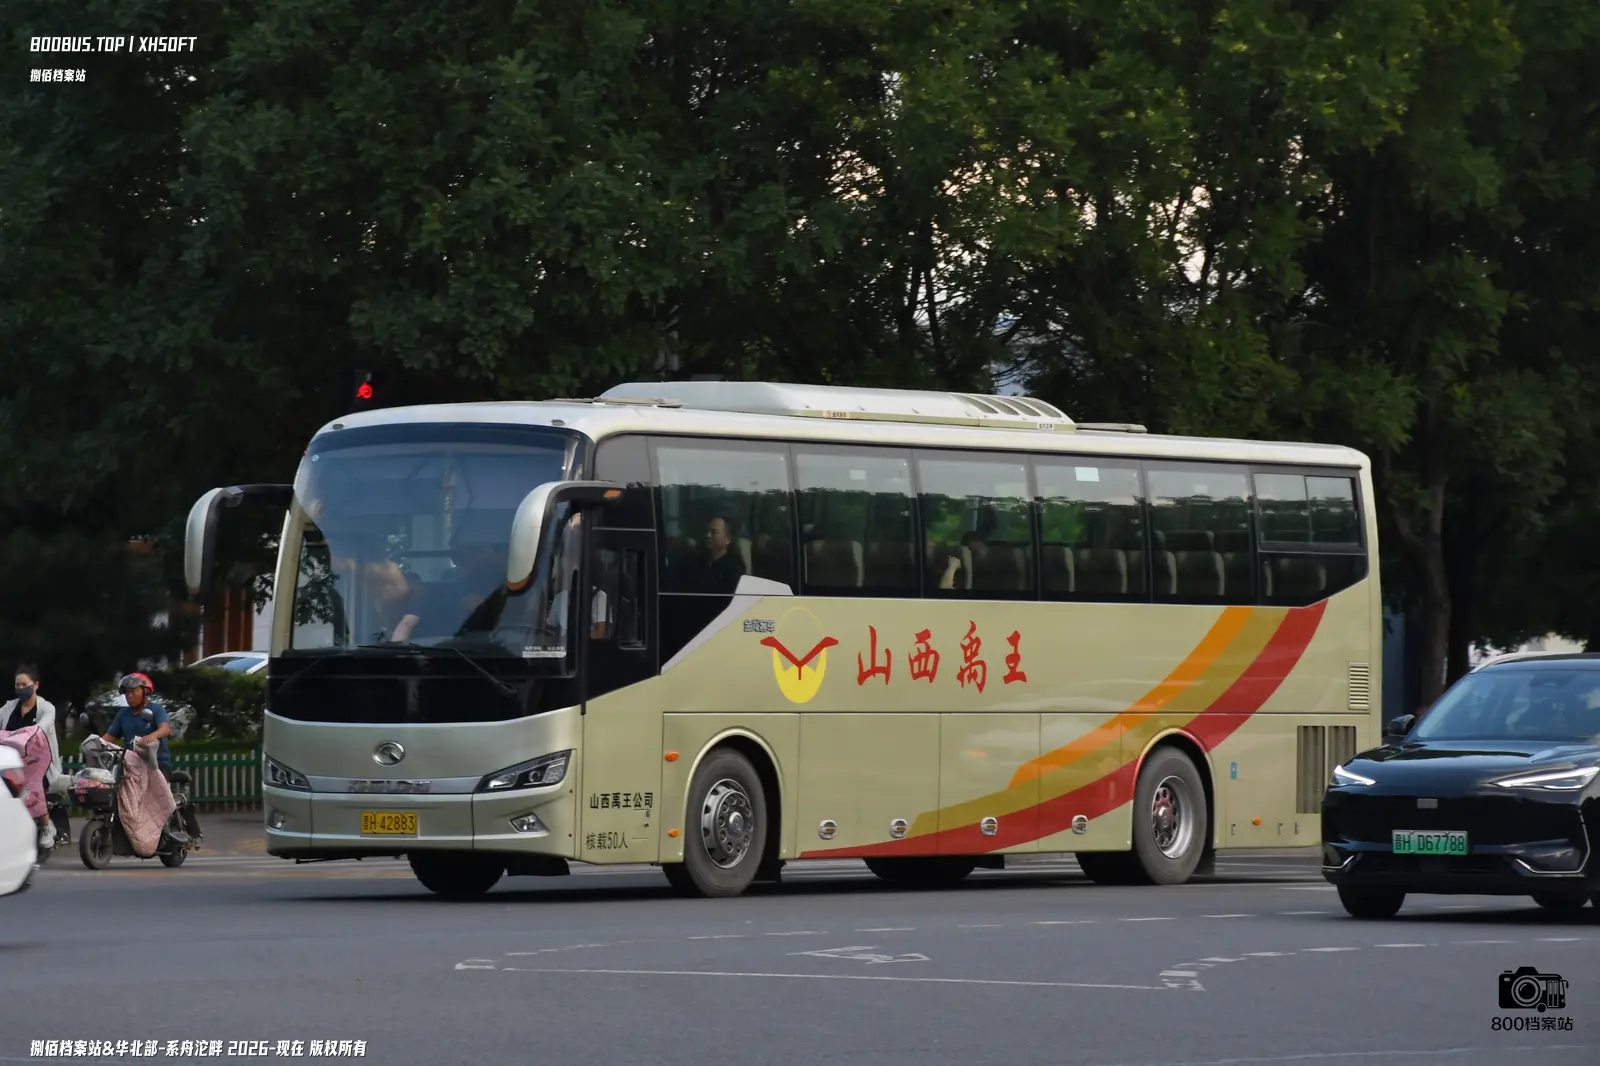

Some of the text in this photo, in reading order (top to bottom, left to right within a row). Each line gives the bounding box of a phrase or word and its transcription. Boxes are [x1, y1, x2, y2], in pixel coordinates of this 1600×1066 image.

[857, 619, 1027, 694] 山西禹王
[590, 792, 653, 809] 山西禹王公司
[586, 832, 628, 849] 核载50人
